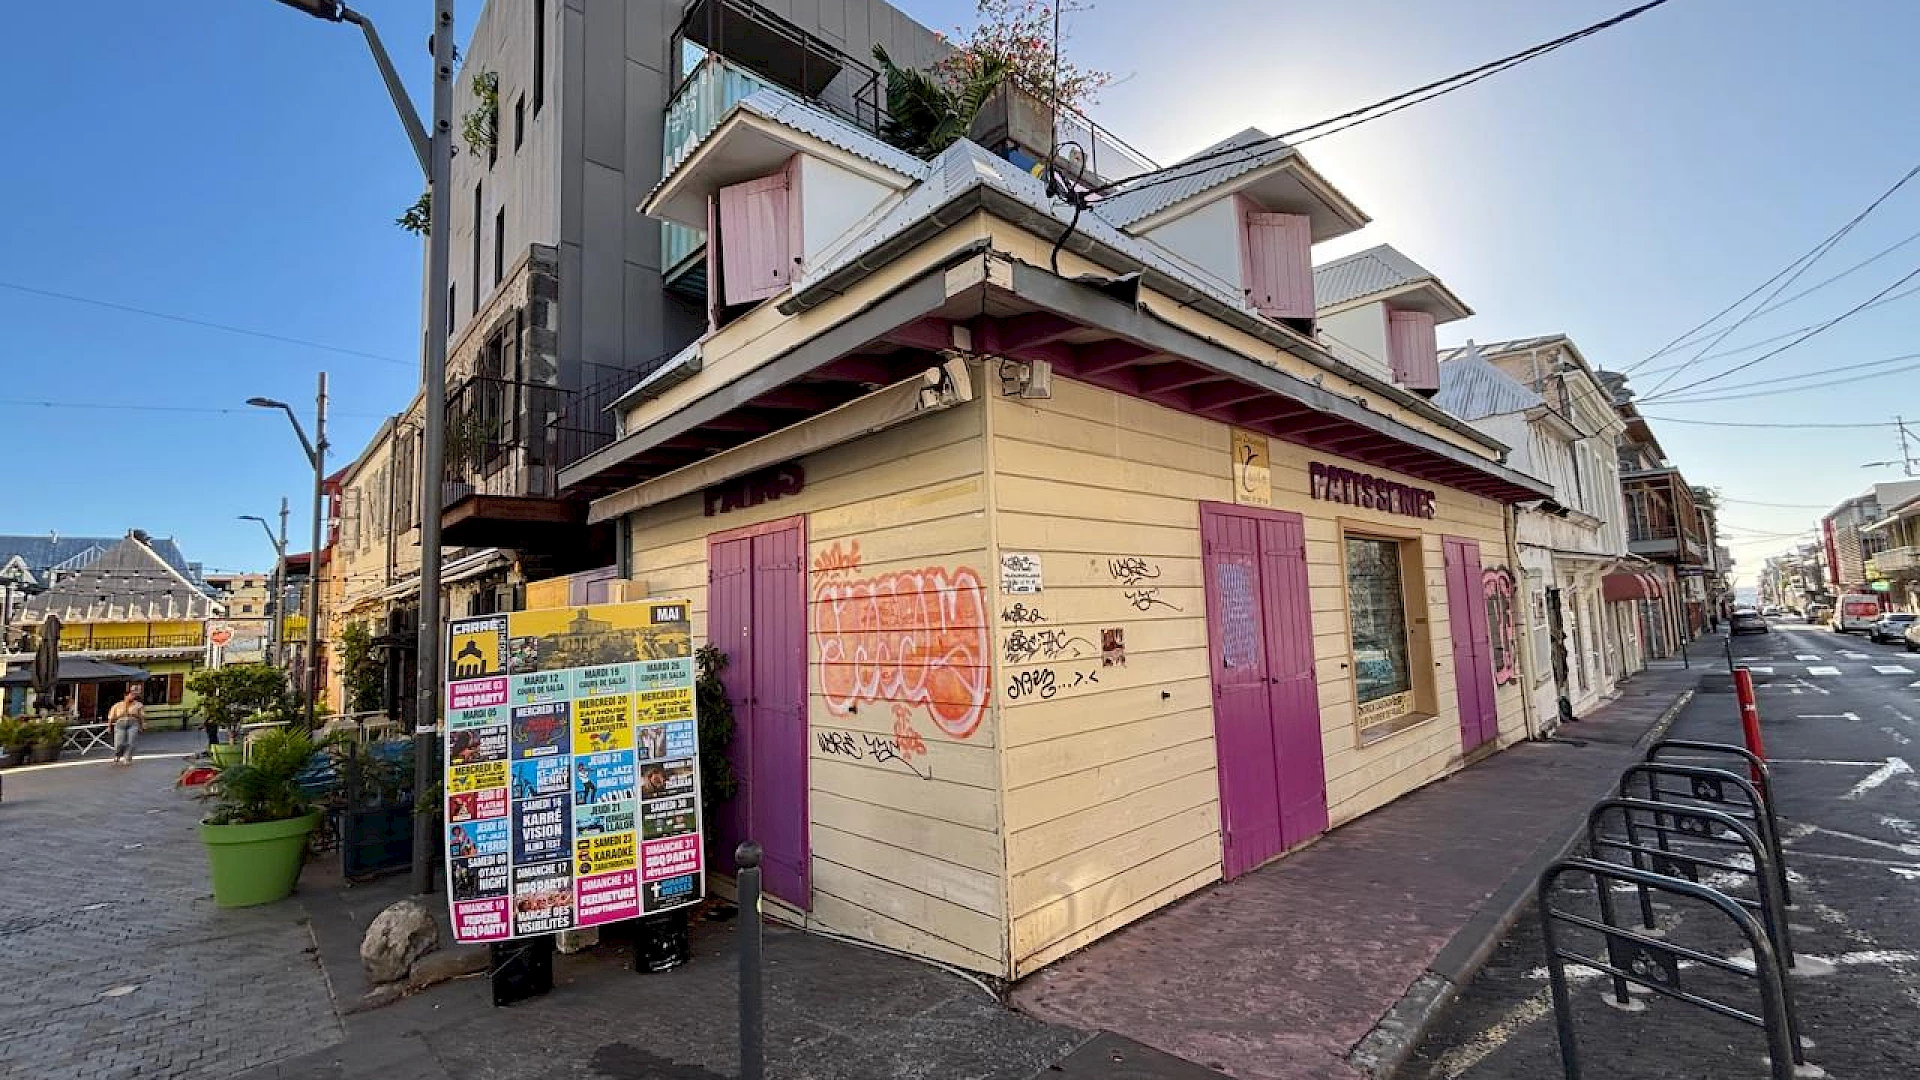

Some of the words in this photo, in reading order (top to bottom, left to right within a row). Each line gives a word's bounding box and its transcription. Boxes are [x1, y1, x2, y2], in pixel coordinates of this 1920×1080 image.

[656, 607, 680, 622] MAI
[584, 668, 608, 678] MARDI
[647, 663, 670, 672] MARDI
[524, 676, 547, 685] MARDI
[550, 674, 558, 682] 12
[455, 682, 491, 694] DIMANCHE
[546, 684, 564, 693] SALSA
[641, 690, 677, 702] MERCREDI
[679, 689, 688, 698] 27
[578, 697, 615, 709] MERCREDI
[618, 696, 627, 704] 20
[462, 709, 486, 720] MARDI
[516, 705, 554, 717] MERCREDI
[613, 753, 622, 762] 21
[455, 763, 491, 775] MERCREDI
[522, 799, 551, 812] SAMEDI
[590, 804, 610, 816] JEUDI
[612, 803, 620, 812] 21
[650, 802, 676, 812] SAMEDI
[523, 809, 562, 826] KARRÉ
[522, 824, 562, 840] VISION
[546, 839, 561, 850] TEST
[594, 836, 621, 848] SAMEDI
[646, 842, 683, 856] DIMANCHE
[468, 855, 495, 868] SAMEDI
[478, 865, 506, 877] OTAKU
[517, 865, 556, 878] DIMANCHE
[558, 862, 567, 872] 17
[479, 877, 507, 891] NIGHT
[582, 877, 621, 891] DIMANCHE
[624, 874, 634, 884] 24
[459, 901, 494, 914] DIMANCHE
[554, 906, 569, 917] DES
